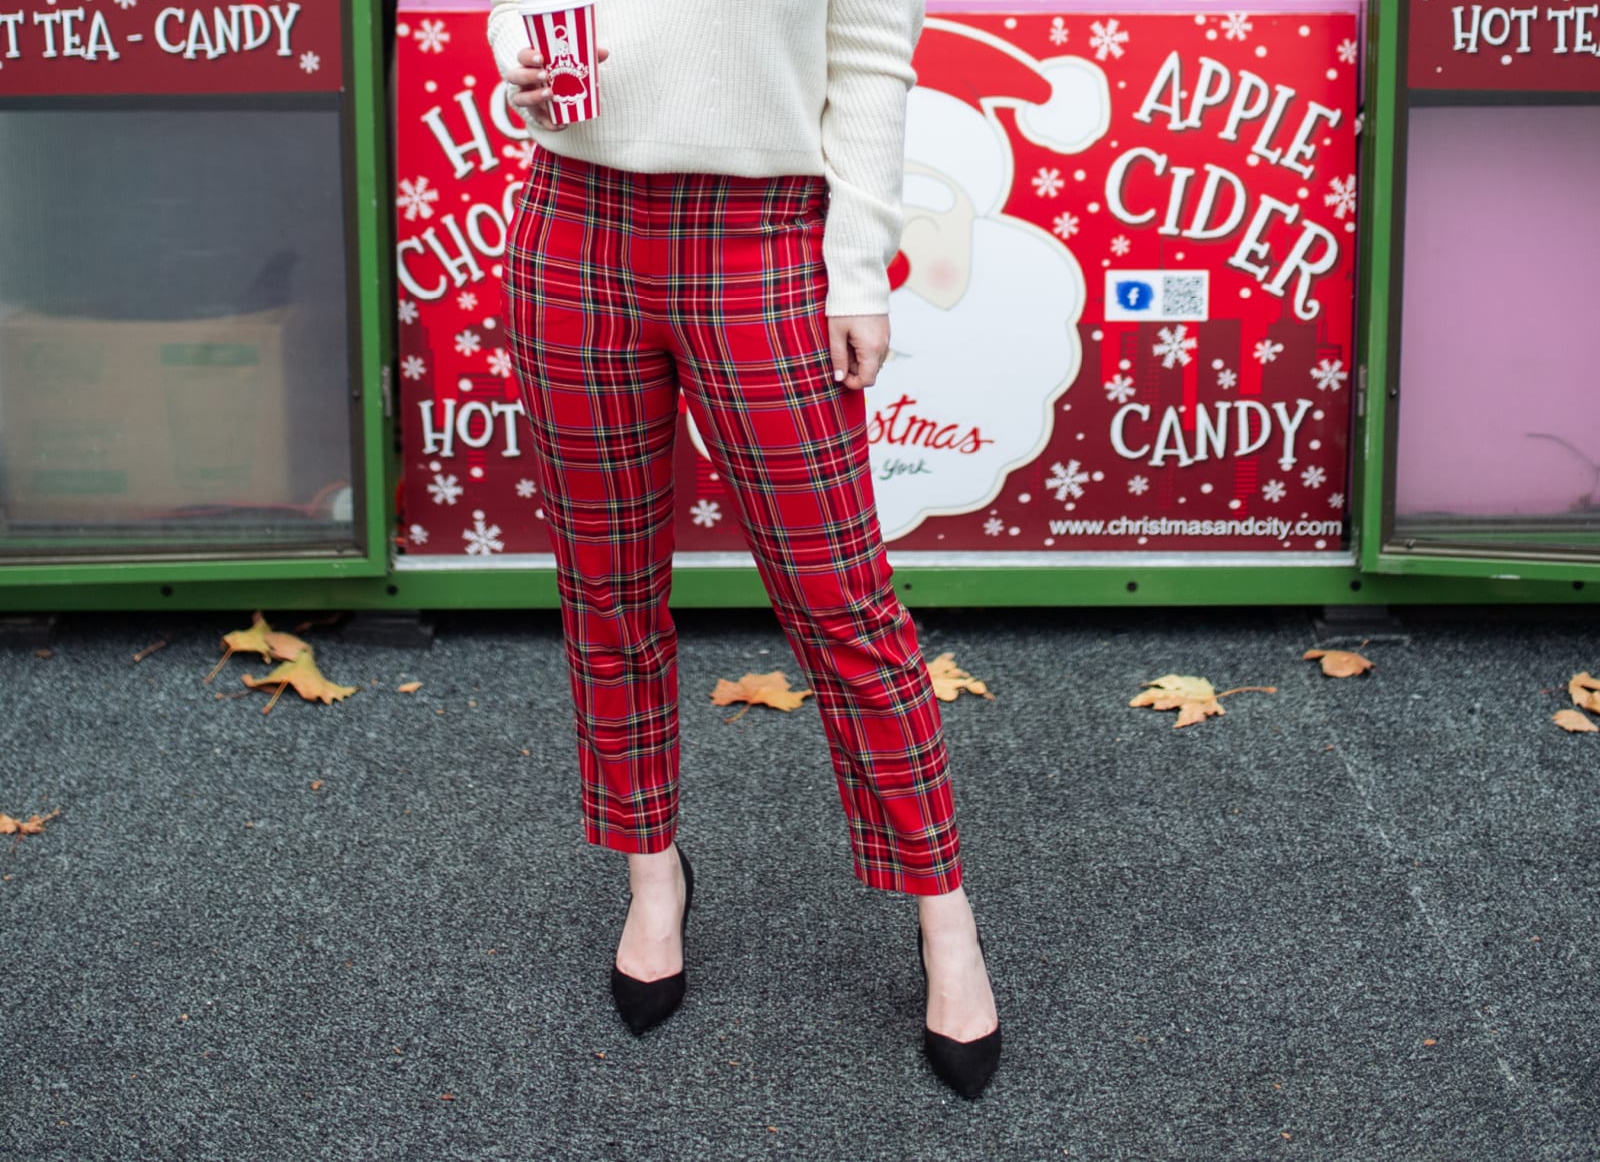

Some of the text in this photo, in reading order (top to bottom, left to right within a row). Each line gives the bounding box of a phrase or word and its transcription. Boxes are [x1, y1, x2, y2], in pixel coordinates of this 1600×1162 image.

[33, 7, 119, 60] TEA
[154, 3, 300, 60] CANDY
[1452, 4, 1600, 56] HOT TE
[1132, 50, 1341, 180] APPLE
[1105, 147, 1338, 320] CIDER
[417, 398, 526, 457] HOT
[1110, 399, 1313, 468] CANDY
[1050, 517, 1343, 541] www.christmasandcity.com
